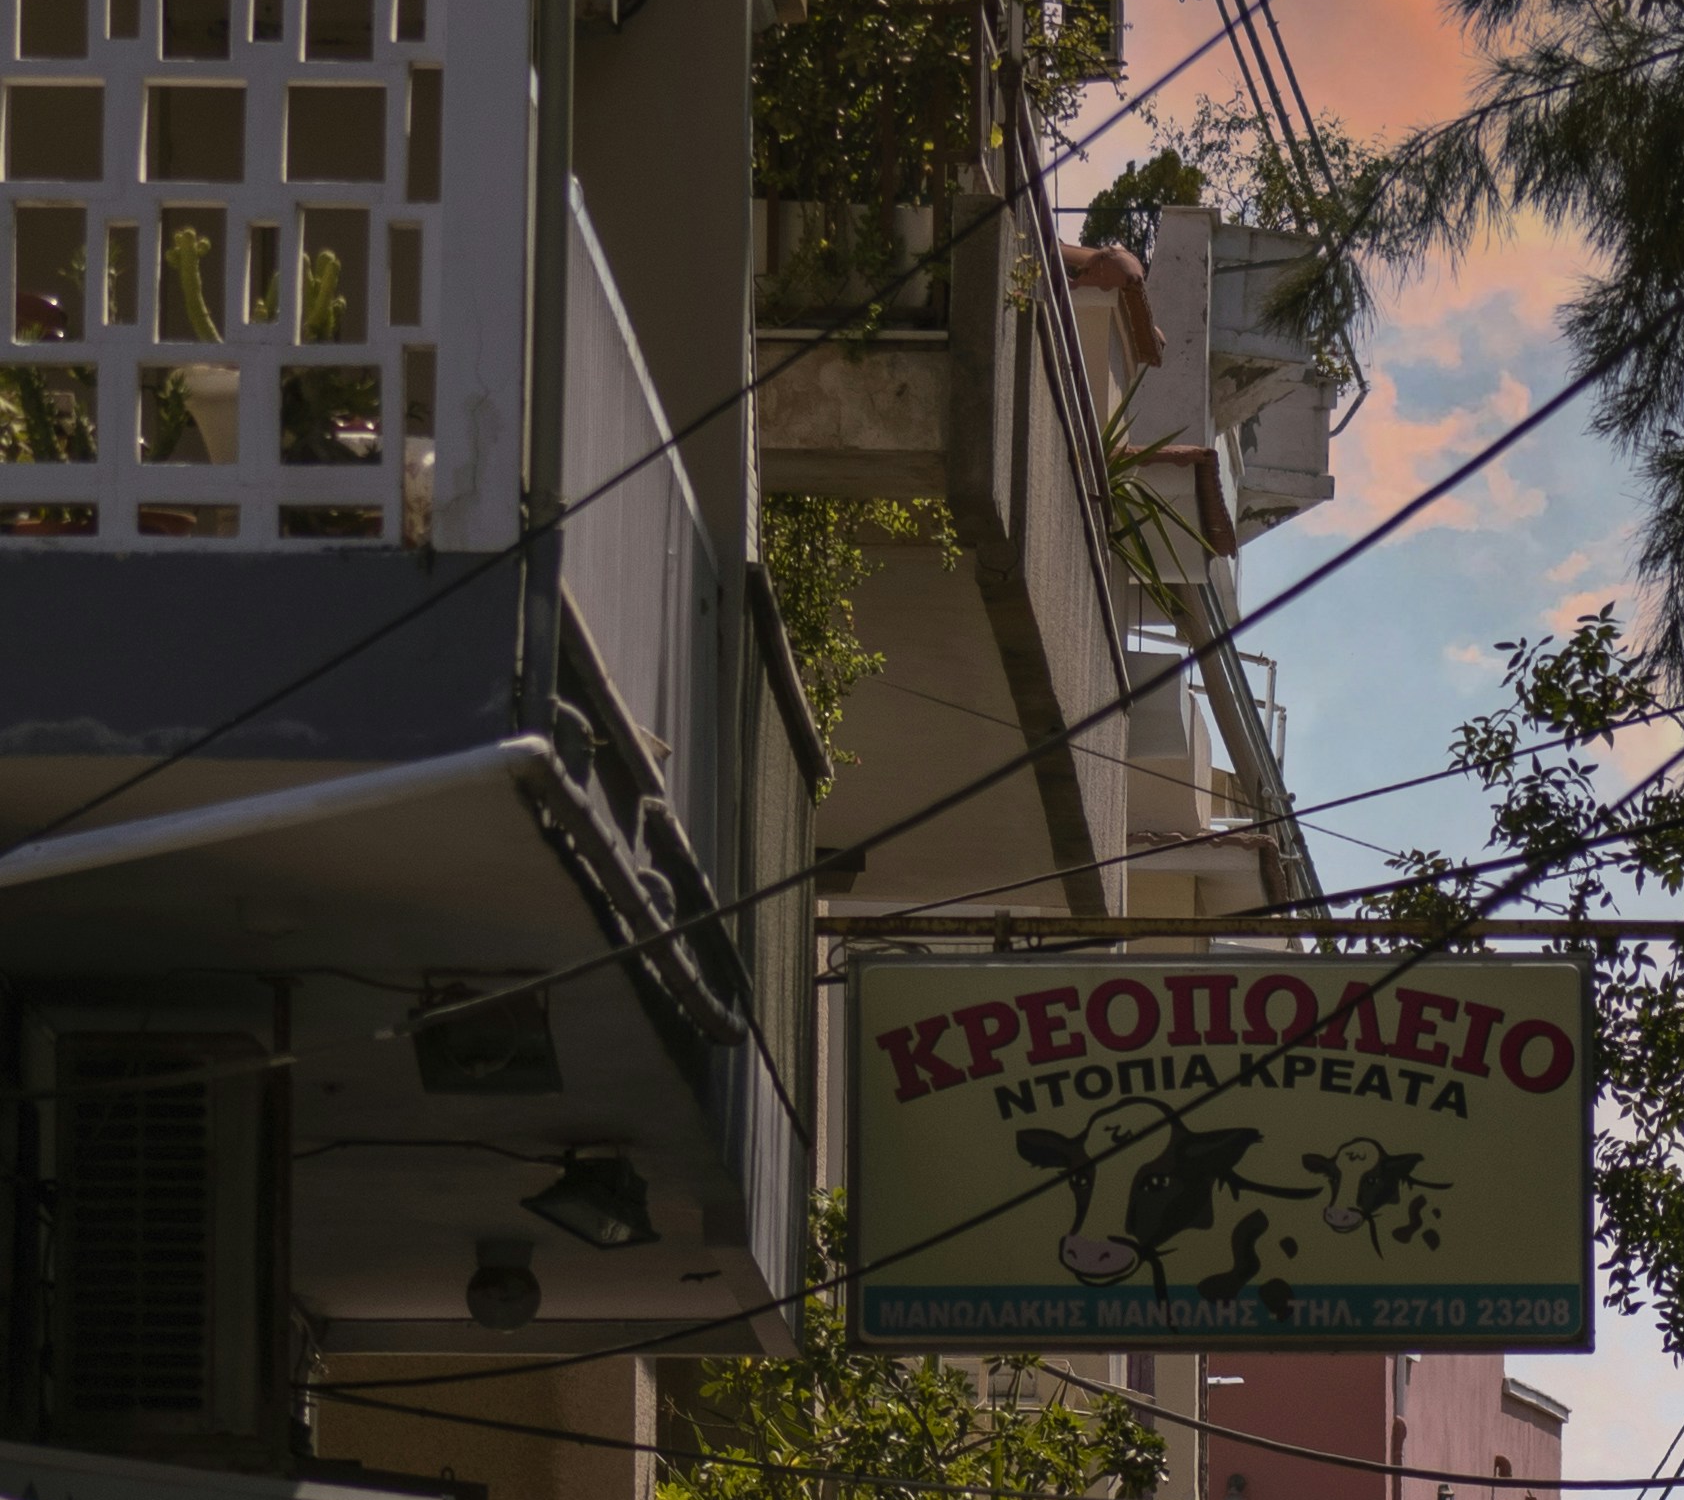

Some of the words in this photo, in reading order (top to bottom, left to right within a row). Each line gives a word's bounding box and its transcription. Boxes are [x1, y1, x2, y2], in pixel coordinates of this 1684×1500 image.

[876, 974, 1574, 1103] ΚΡΕΟΠΩΛΕΙΟ
[994, 1054, 1217, 1119] ΝΤΟΠΙΑ
[1239, 1053, 1468, 1119] ΚΡΕΑΤΑ
[880, 1299, 1087, 1328] ΜΑΝΩΛΑΚΗΣ
[1098, 1299, 1258, 1328] ΜΑΝΩΛΗΣ
[1289, 1299, 1361, 1328] ΤΗΛ.
[1373, 1299, 1464, 1328] 22710
[1477, 1299, 1570, 1328] 23208
